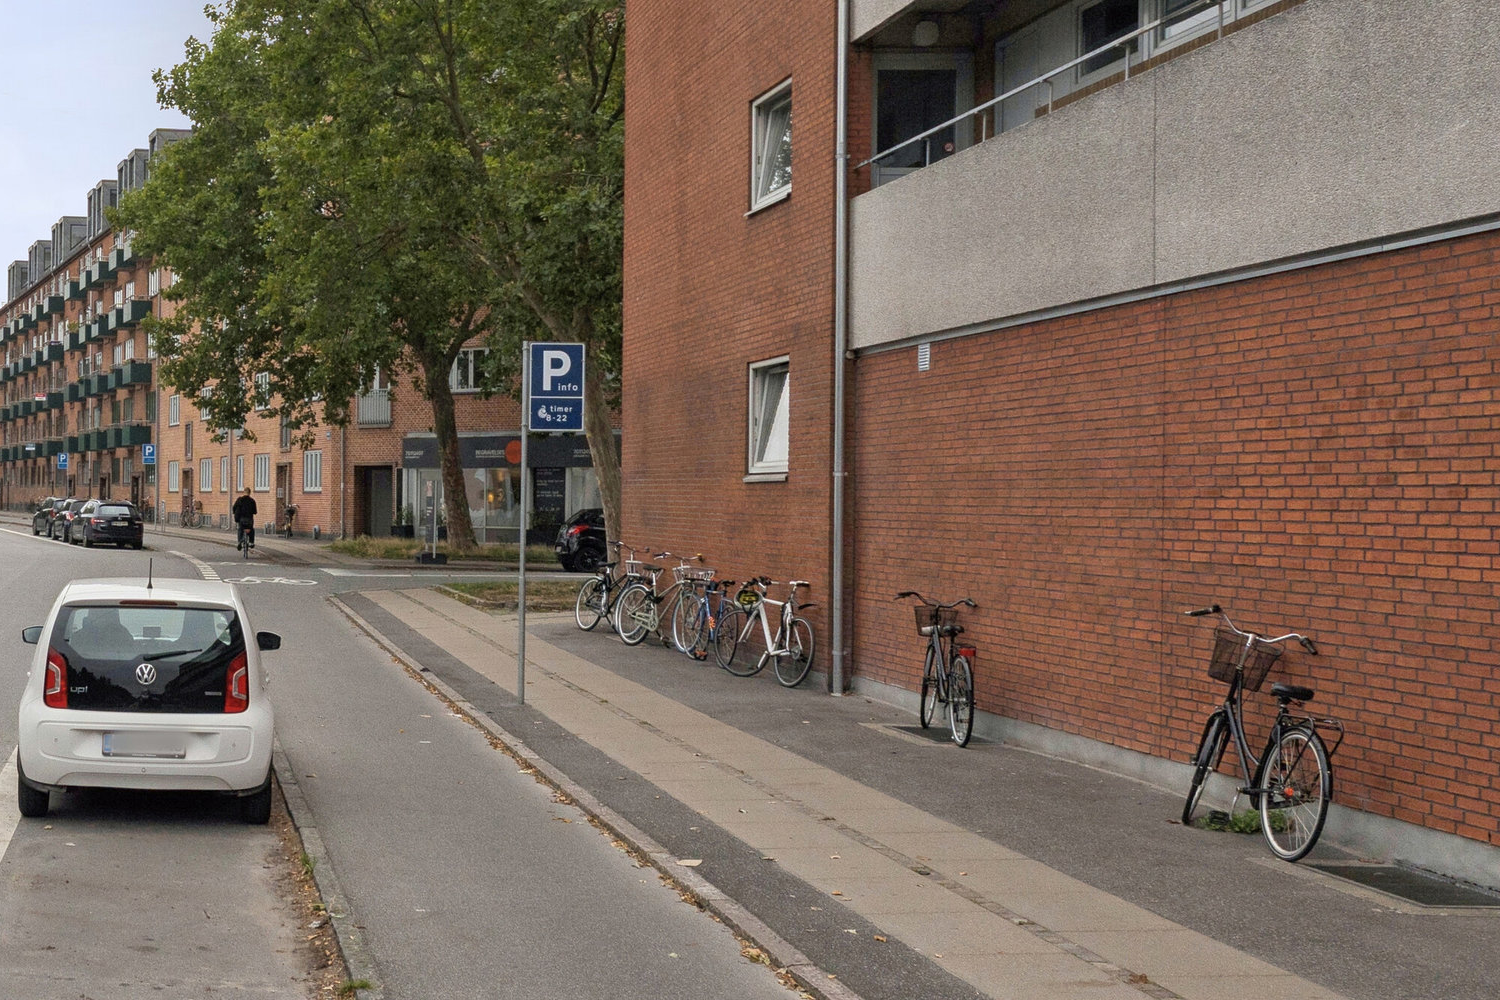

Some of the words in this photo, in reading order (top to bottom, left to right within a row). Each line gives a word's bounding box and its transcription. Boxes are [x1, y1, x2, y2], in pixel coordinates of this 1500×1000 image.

[543, 350, 571, 391] P
[557, 383, 579, 391] info
[145, 446, 153, 456] P
[60, 454, 66, 462] P
[70, 686, 88, 694] up!
